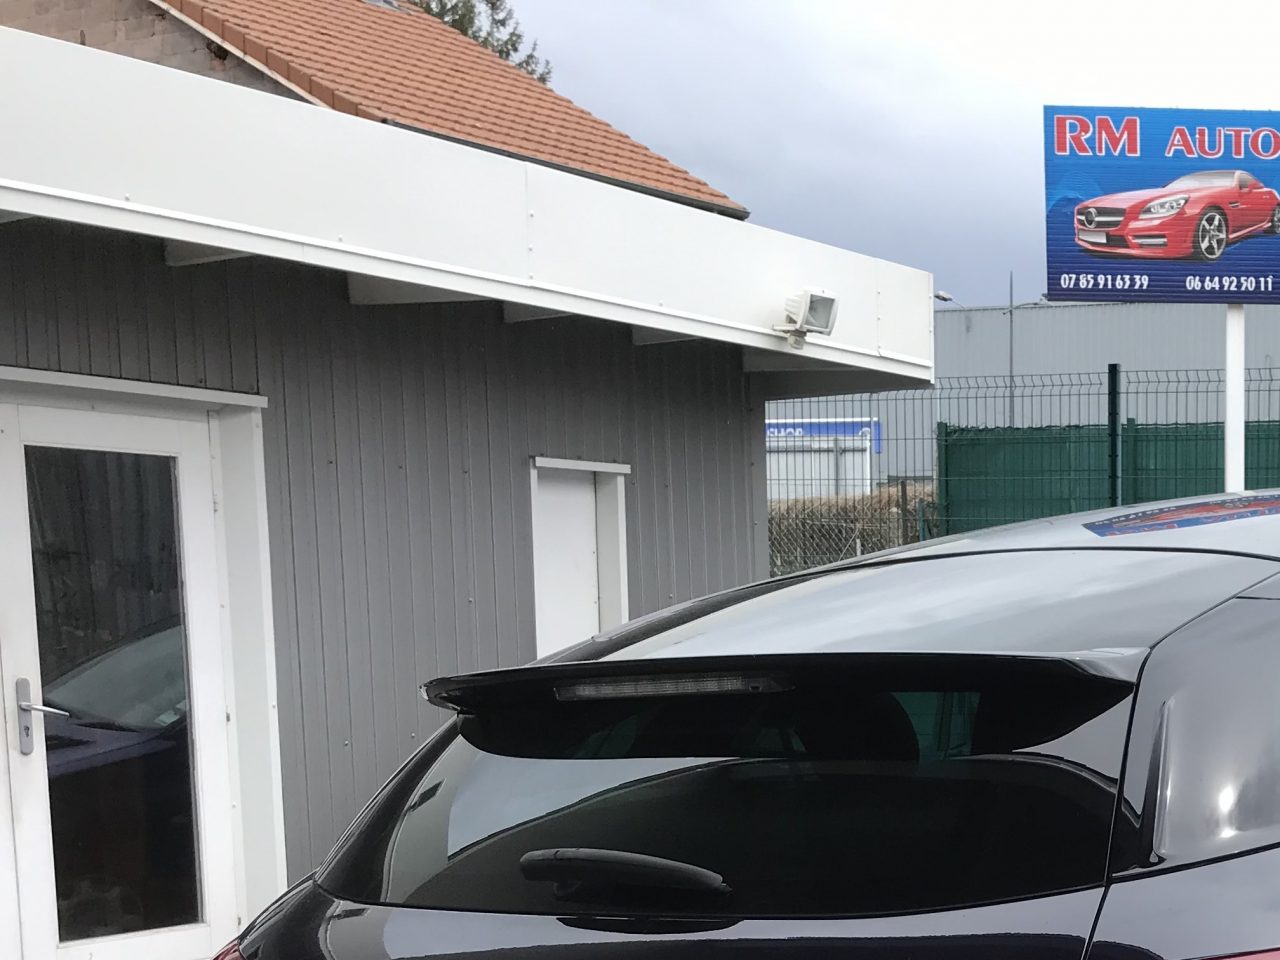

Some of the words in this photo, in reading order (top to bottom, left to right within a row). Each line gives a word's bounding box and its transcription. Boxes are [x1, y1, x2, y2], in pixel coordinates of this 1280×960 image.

[1054, 114, 1141, 157] RM
[1060, 273, 1077, 289] 07
[1079, 273, 1095, 289] 85
[1097, 274, 1113, 289] 91
[1115, 274, 1131, 290] 63
[1133, 275, 1149, 290] 39
[1185, 275, 1202, 291] 06
[1204, 276, 1221, 291] 64
[1222, 276, 1238, 291] 92
[1240, 276, 1256, 292] 50
[1258, 275, 1274, 292] 11
